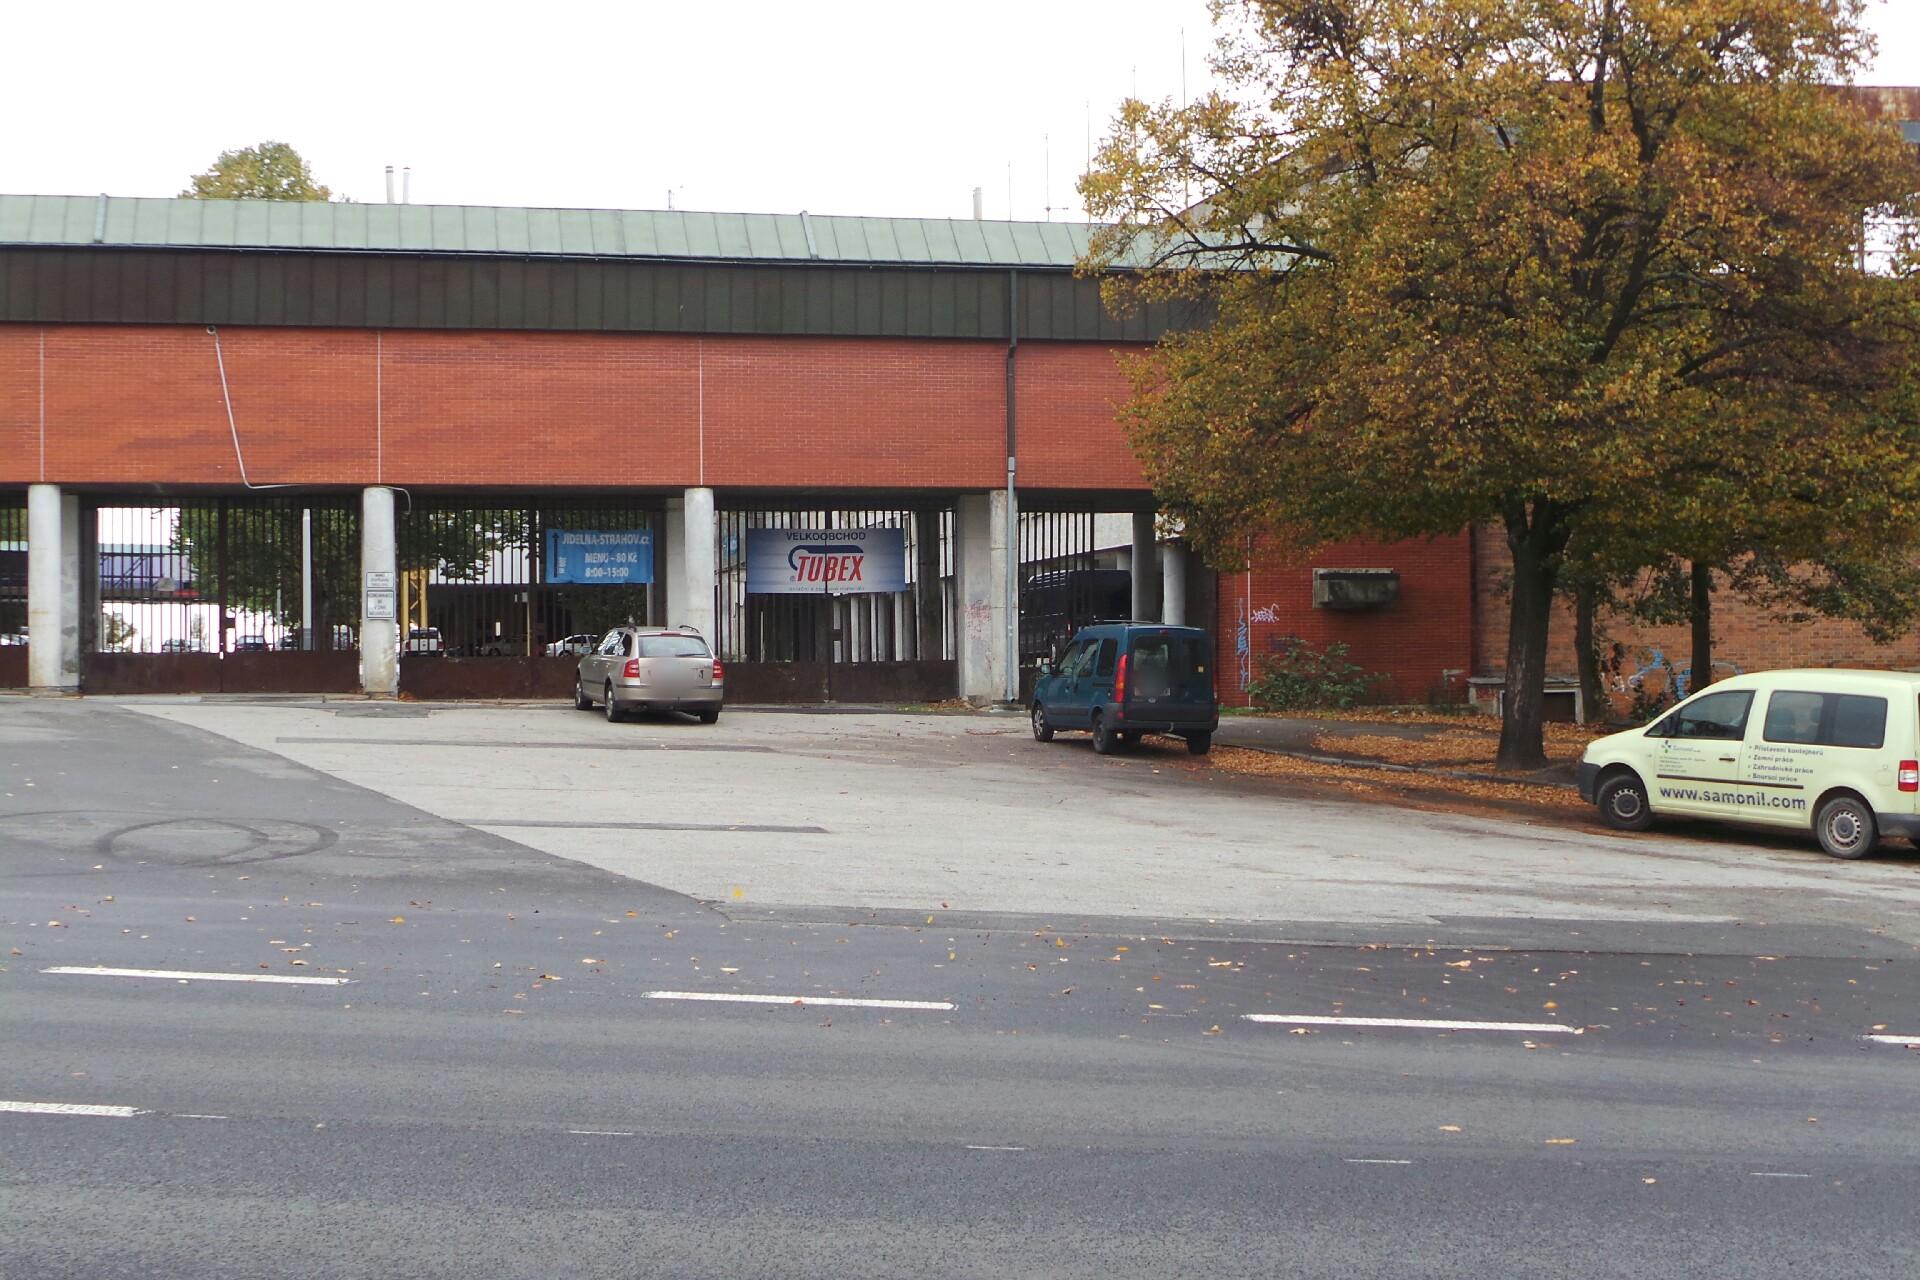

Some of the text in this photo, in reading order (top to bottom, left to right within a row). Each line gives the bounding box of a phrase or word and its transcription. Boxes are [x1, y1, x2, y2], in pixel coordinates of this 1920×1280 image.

[786, 531, 866, 541] VELKOOBCHOD
[585, 552, 609, 563] MENU
[797, 555, 864, 582] TUBEX
[1779, 775, 1798, 783] práce
[1660, 786, 1806, 810] www.samonil.com
